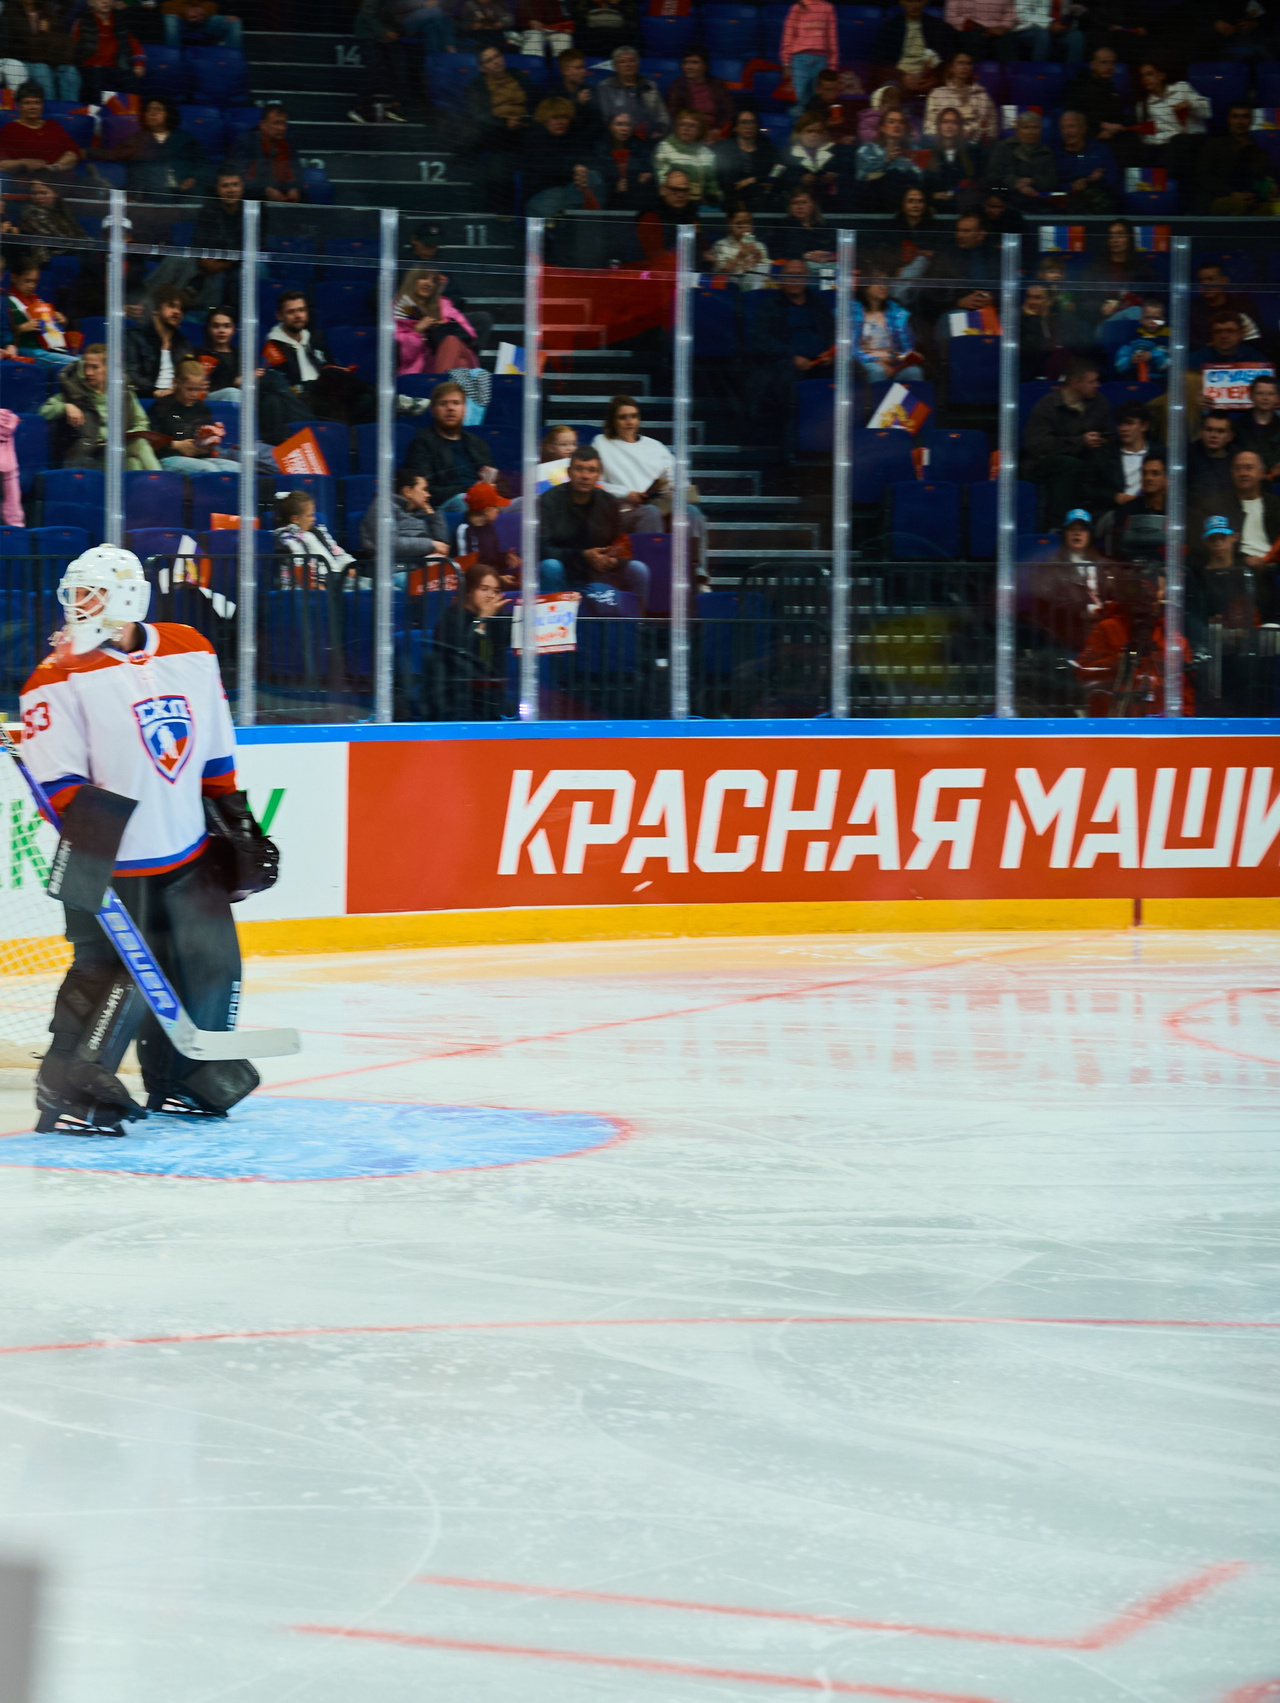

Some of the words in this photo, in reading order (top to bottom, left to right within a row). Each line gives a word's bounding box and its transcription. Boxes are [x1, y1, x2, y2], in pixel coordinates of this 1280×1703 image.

[335, 45, 361, 66] 14
[419, 161, 447, 183] 12
[465, 224, 488, 246] 11
[497, 767, 986, 876] КРАСНАЯ
[101, 911, 177, 1011] BAUER
